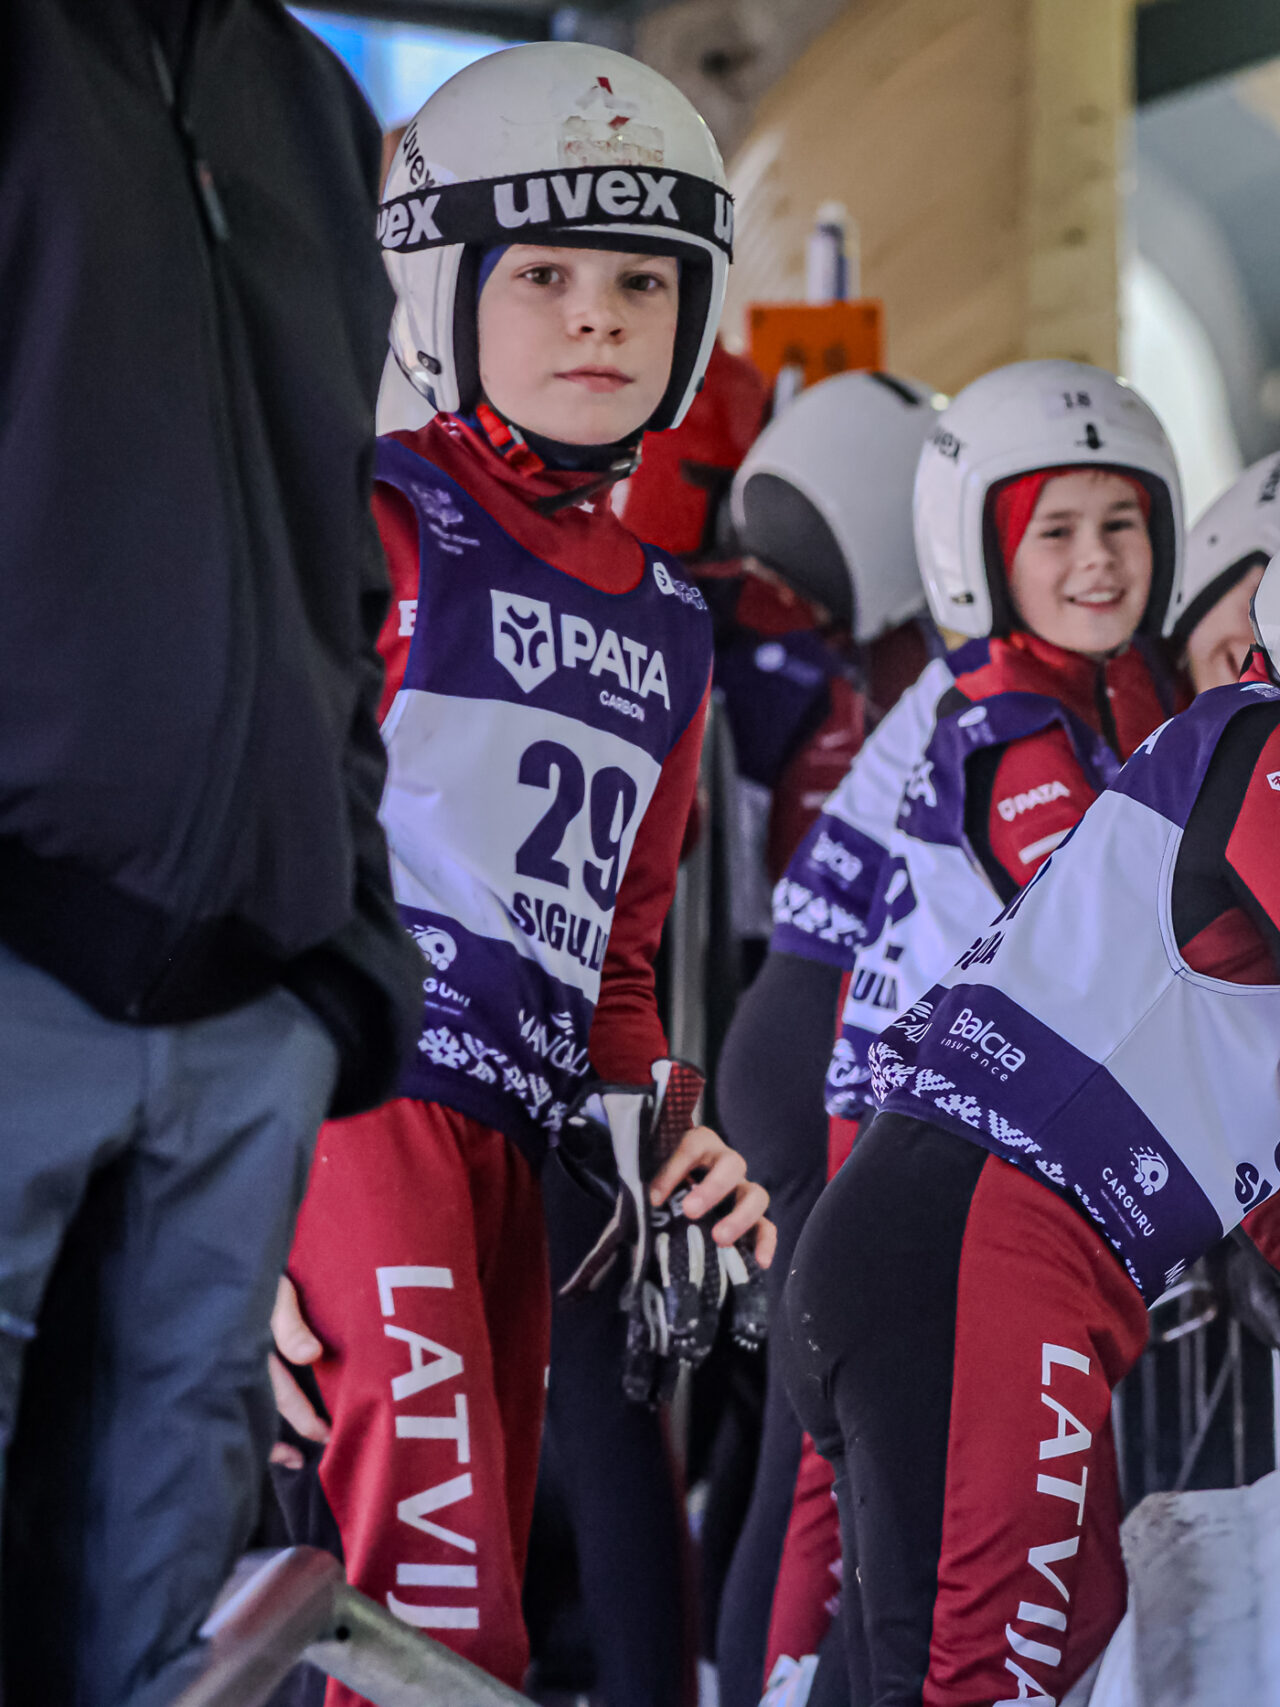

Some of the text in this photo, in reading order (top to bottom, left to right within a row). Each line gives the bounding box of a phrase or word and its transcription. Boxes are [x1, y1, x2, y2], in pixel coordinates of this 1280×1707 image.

[494, 170, 680, 229] uvex
[561, 614, 671, 710] PATA
[600, 690, 645, 722] CARBON
[515, 740, 638, 912] 29
[940, 1037, 1009, 1082] insurance
[949, 1008, 1026, 1072] Balcia
[1102, 1167, 1155, 1237] CARGURU
[992, 1342, 1093, 1707] LATVIJA
